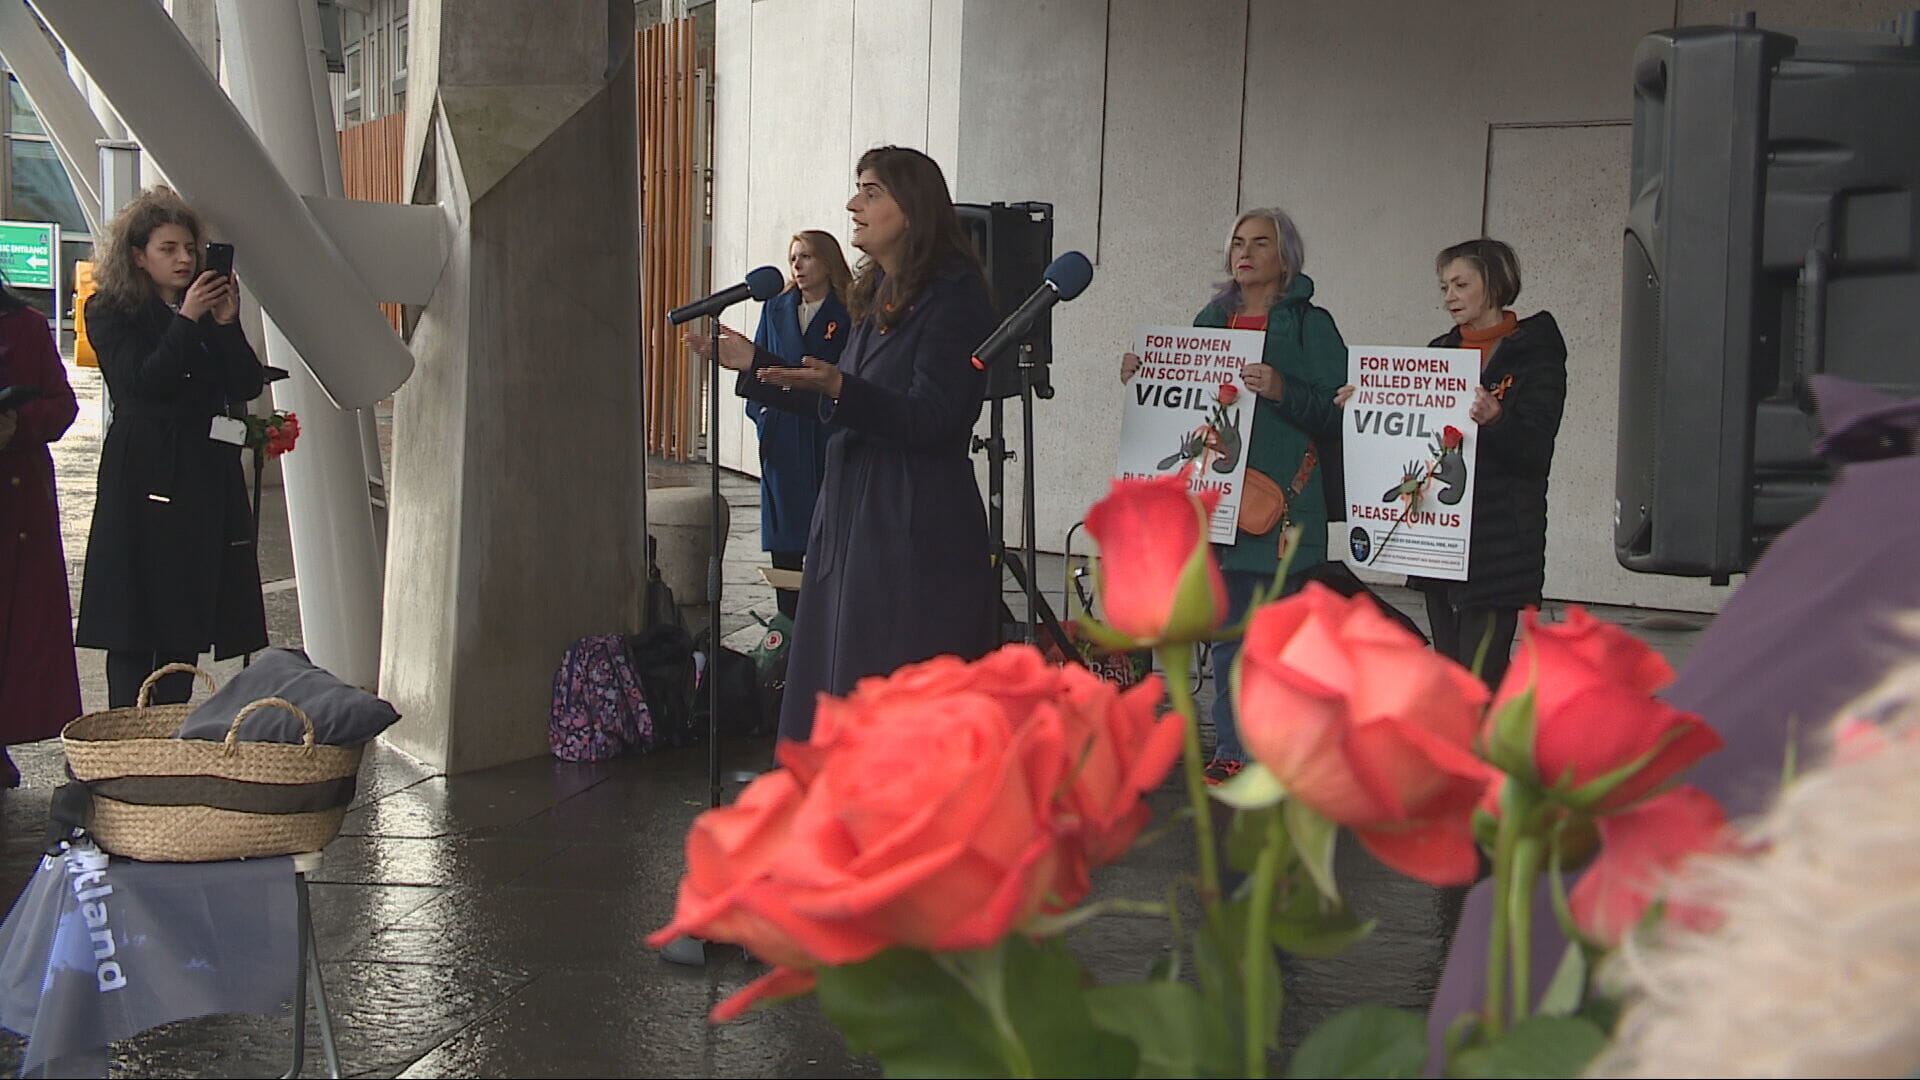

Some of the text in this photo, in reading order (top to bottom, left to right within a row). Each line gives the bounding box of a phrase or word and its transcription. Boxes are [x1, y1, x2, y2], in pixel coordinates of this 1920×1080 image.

[11, 245, 48, 255] ENTRANCE
[1145, 335, 1231, 352] FOR WOMEN
[1143, 351, 1246, 369] KILLED BY MEN
[1360, 357, 1449, 373] FOR WOMEN
[1140, 367, 1234, 384] IN SCOTLAND
[1360, 374, 1467, 392] KILLED BY MEN
[1135, 383, 1208, 411] VIGIL
[1358, 391, 1456, 409] IN SCOTLAND
[1353, 409, 1431, 438] VIGIL
[1352, 505, 1399, 522] PLEASE
[1440, 513, 1461, 528] US
